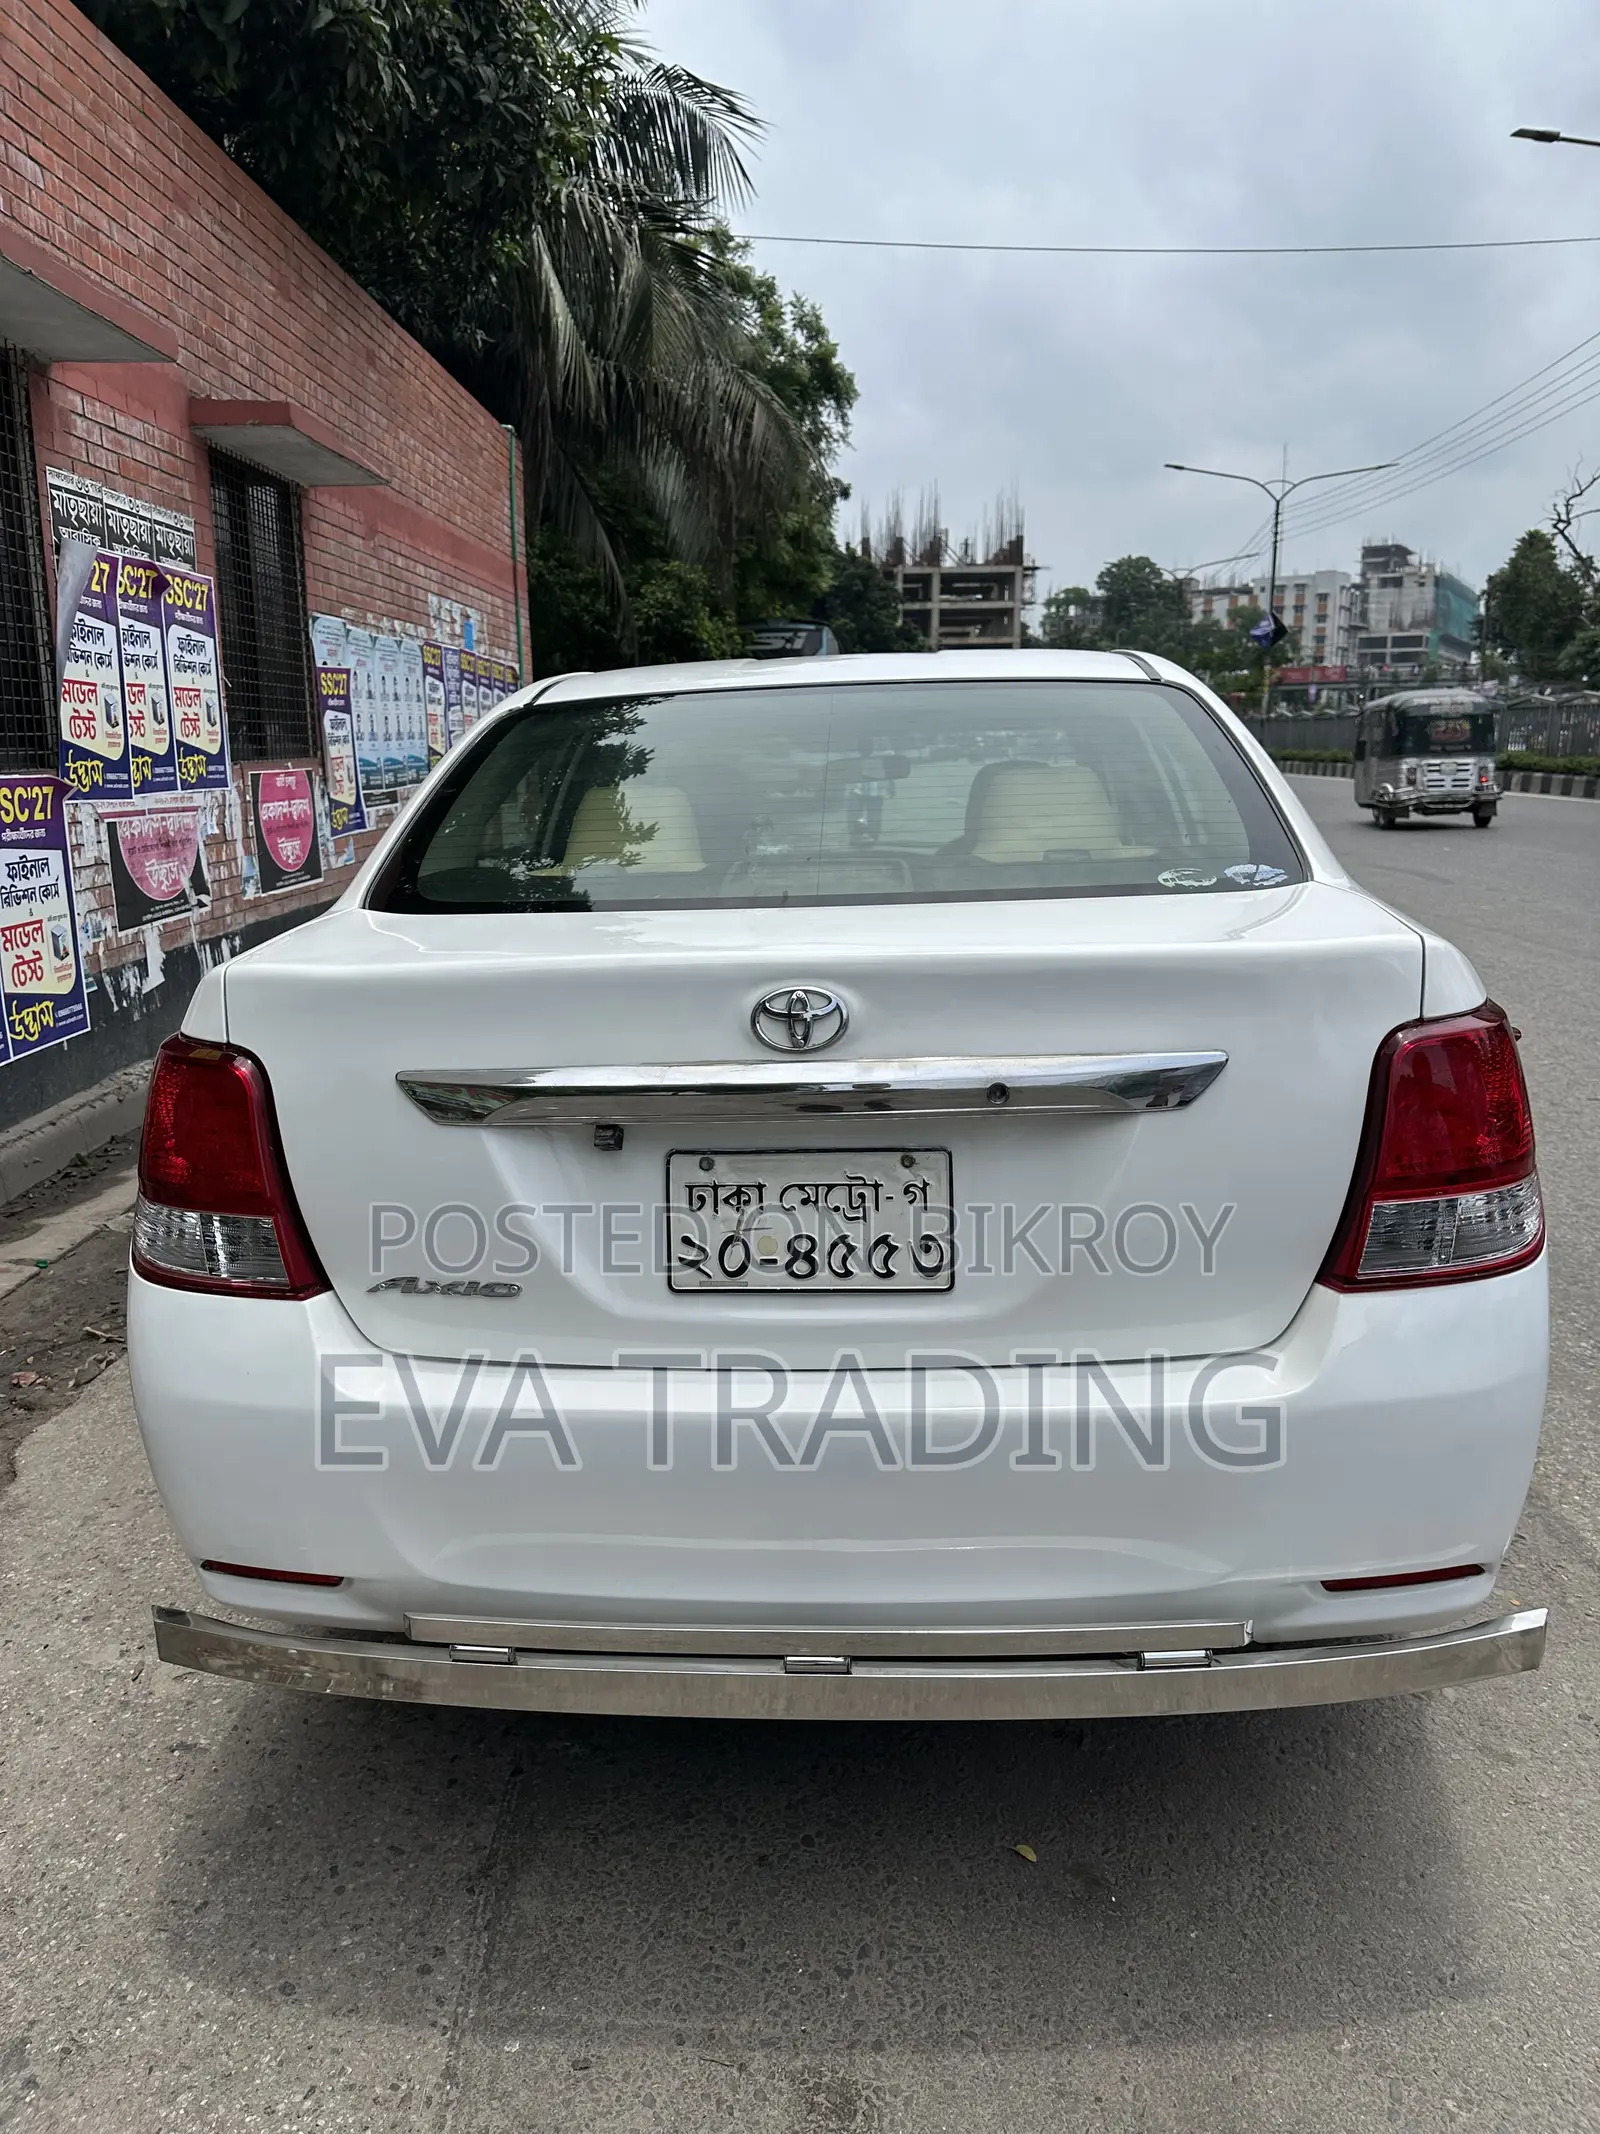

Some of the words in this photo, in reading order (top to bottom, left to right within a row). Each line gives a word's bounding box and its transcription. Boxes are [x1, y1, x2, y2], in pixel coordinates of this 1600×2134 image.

[50, 488, 102, 528] মাতৃছায়া
[105, 508, 151, 545] মাতৃছায়া
[154, 523, 194, 557] মাতৃছায়া
[94, 649, 112, 670] কোর্স
[177, 634, 207, 657] ফাইনাল
[62, 678, 98, 706] মডেল
[173, 686, 203, 709] মডেল
[69, 707, 97, 740] টেস্ট
[180, 711, 201, 738] টেস্ট
[5, 854, 51, 882] ফাইনাল
[0, 883, 37, 909] রিভিশন
[39, 875, 60, 905] কোর্স
[0, 919, 45, 953] মডেল
[11, 950, 44, 988] টেস্ট
[684, 1180, 768, 1216] ঢাকা
[779, 1169, 932, 1224] মেট্রো-গ
[678, 1233, 945, 1280] ২০-৪৫৫৩
